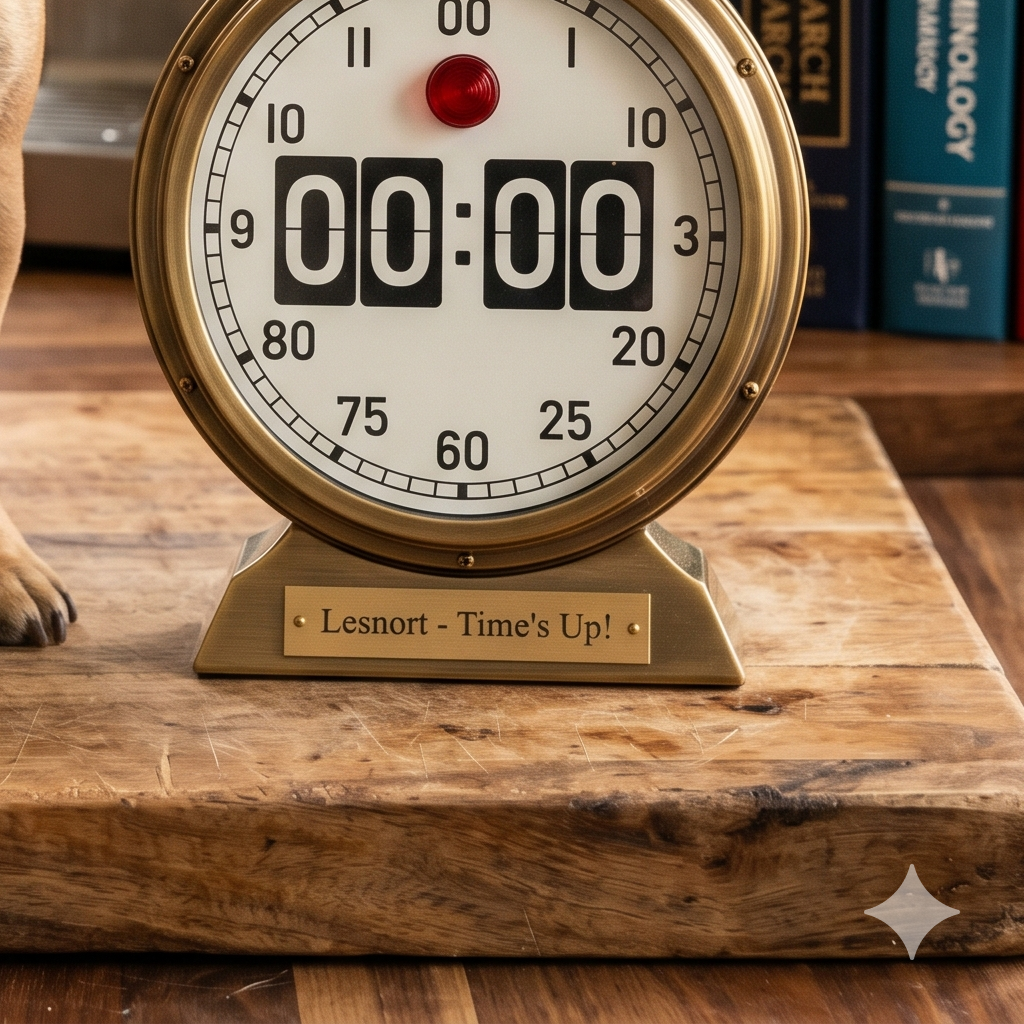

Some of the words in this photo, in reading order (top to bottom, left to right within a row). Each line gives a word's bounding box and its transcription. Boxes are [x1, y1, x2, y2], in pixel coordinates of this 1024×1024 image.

[347, 26, 372, 68] 11
[566, 26, 577, 69] 1
[267, 103, 306, 145] 10
[627, 106, 668, 149] 10
[230, 208, 256, 250] 9
[284, 174, 643, 292] 00:00
[673, 214, 700, 258] 3
[262, 319, 316, 361] 80
[612, 325, 666, 368] 20
[336, 395, 390, 437] 75
[539, 399, 592, 442] 25
[436, 429, 490, 472] 60
[320, 608, 429, 636] Lesnort
[456, 611, 551, 639] Time's
[559, 612, 612, 647] Up!
